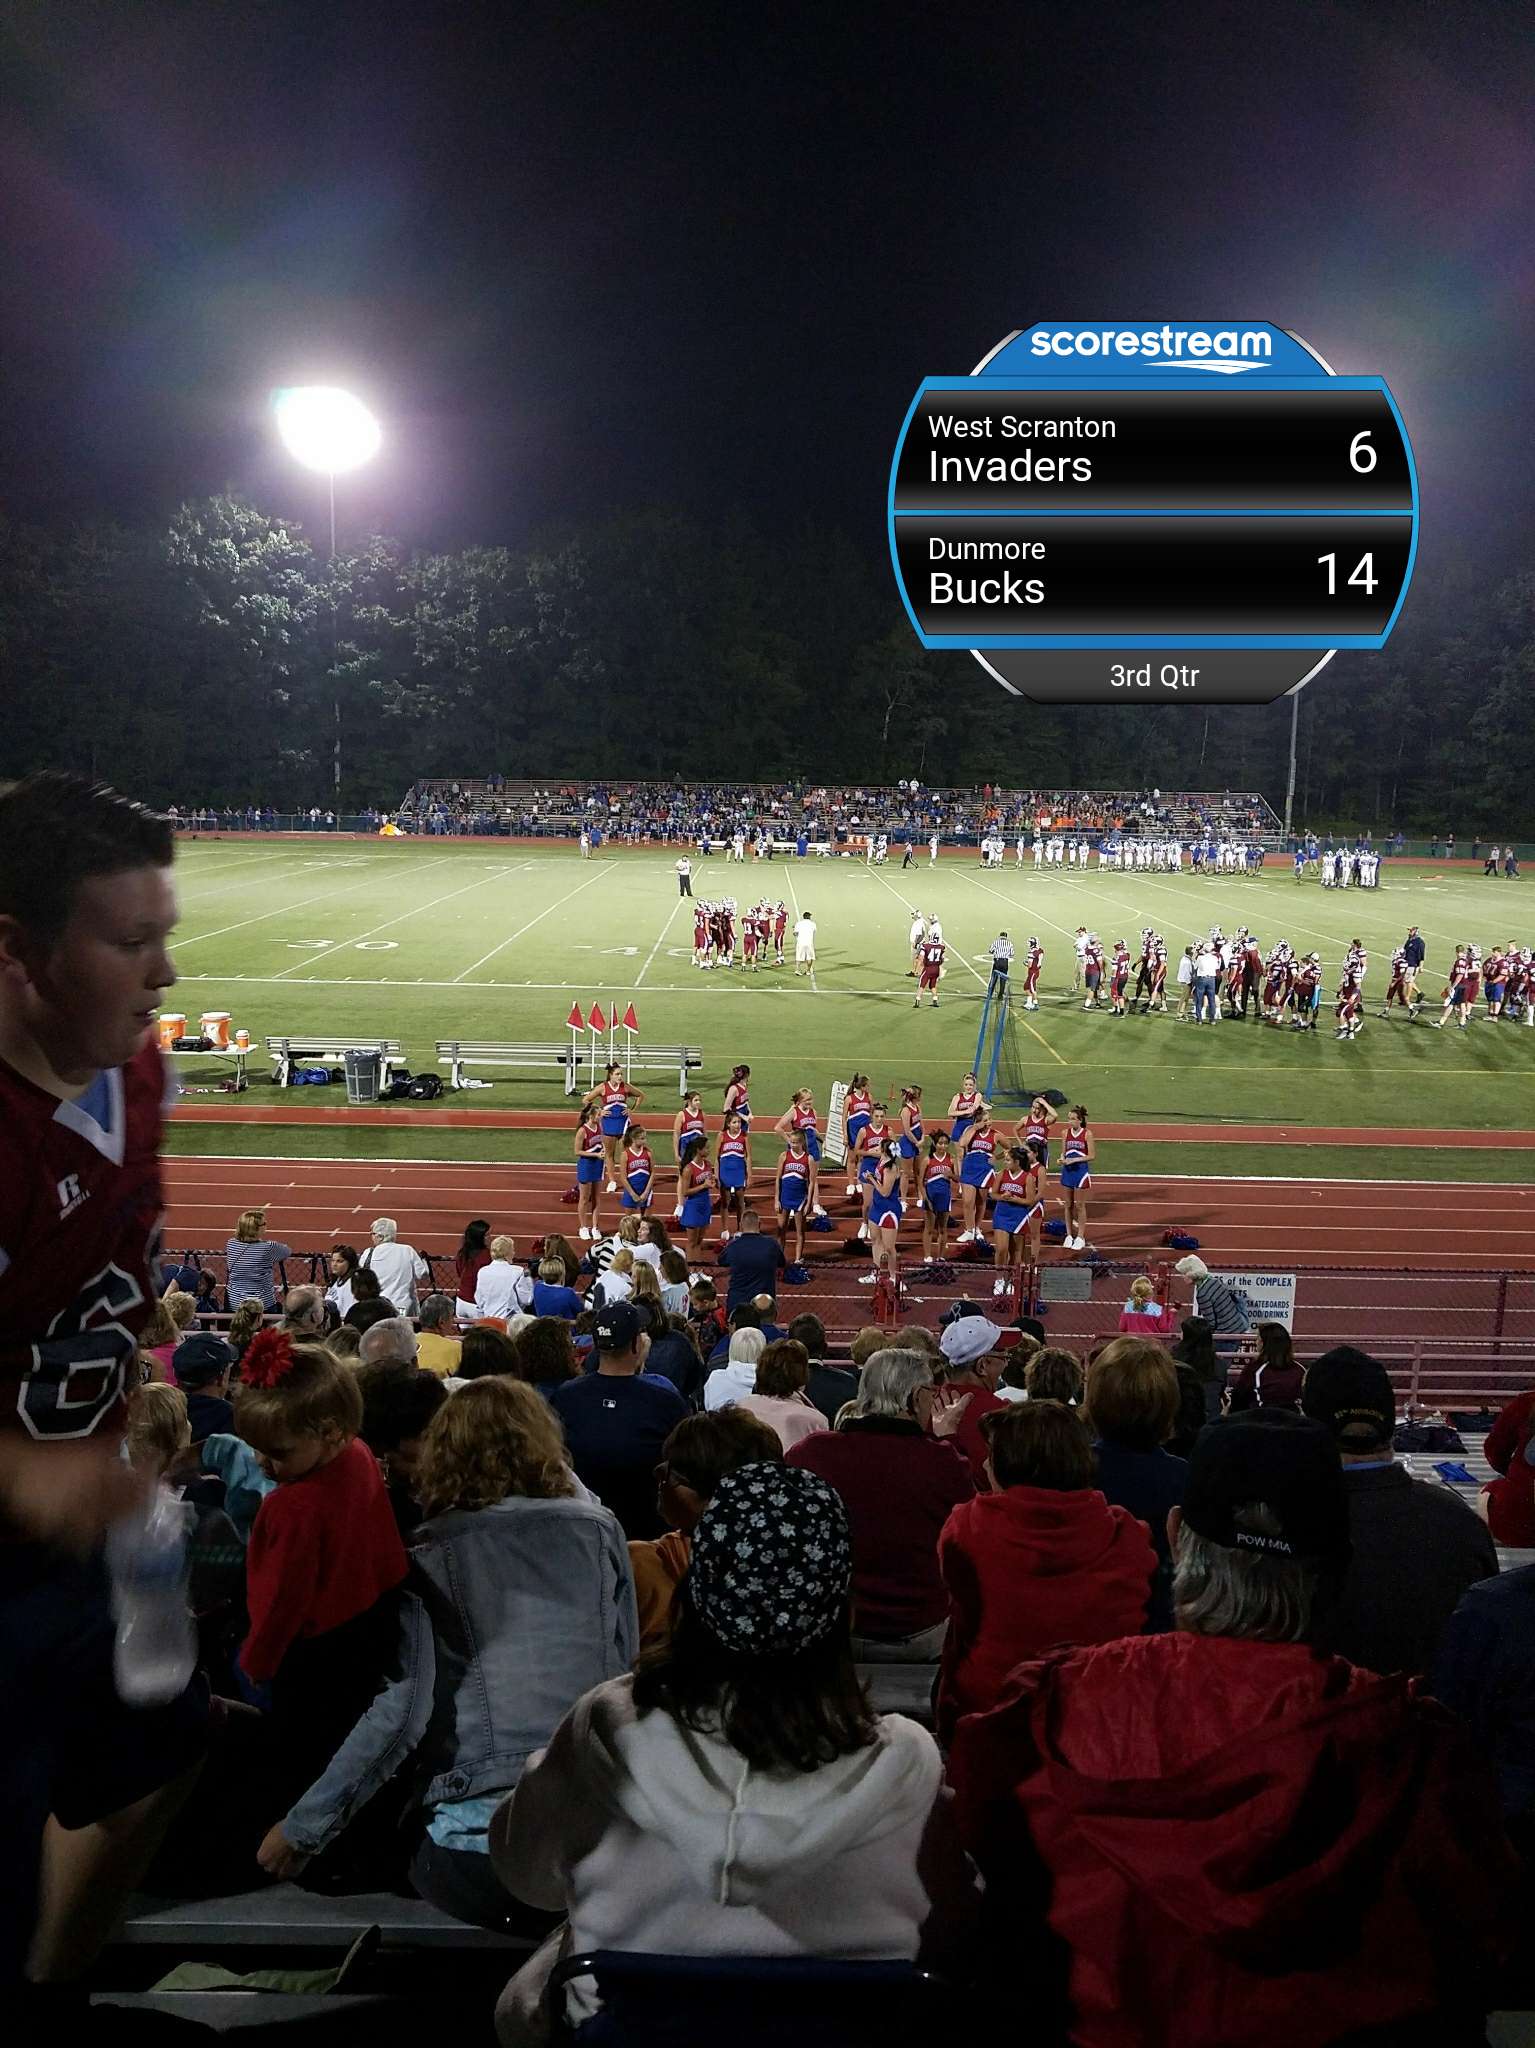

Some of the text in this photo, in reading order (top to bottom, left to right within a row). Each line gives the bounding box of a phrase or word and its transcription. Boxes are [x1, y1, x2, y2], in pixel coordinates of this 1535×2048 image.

[927, 947, 942, 962] 47
[1227, 1276, 1236, 1286] of
[1239, 1276, 1252, 1286] the
[1255, 1277, 1292, 1287] COMPLEX
[1247, 1310, 1289, 1319] OOD/DRINKS
[1236, 1533, 1292, 1553] POW MIA
